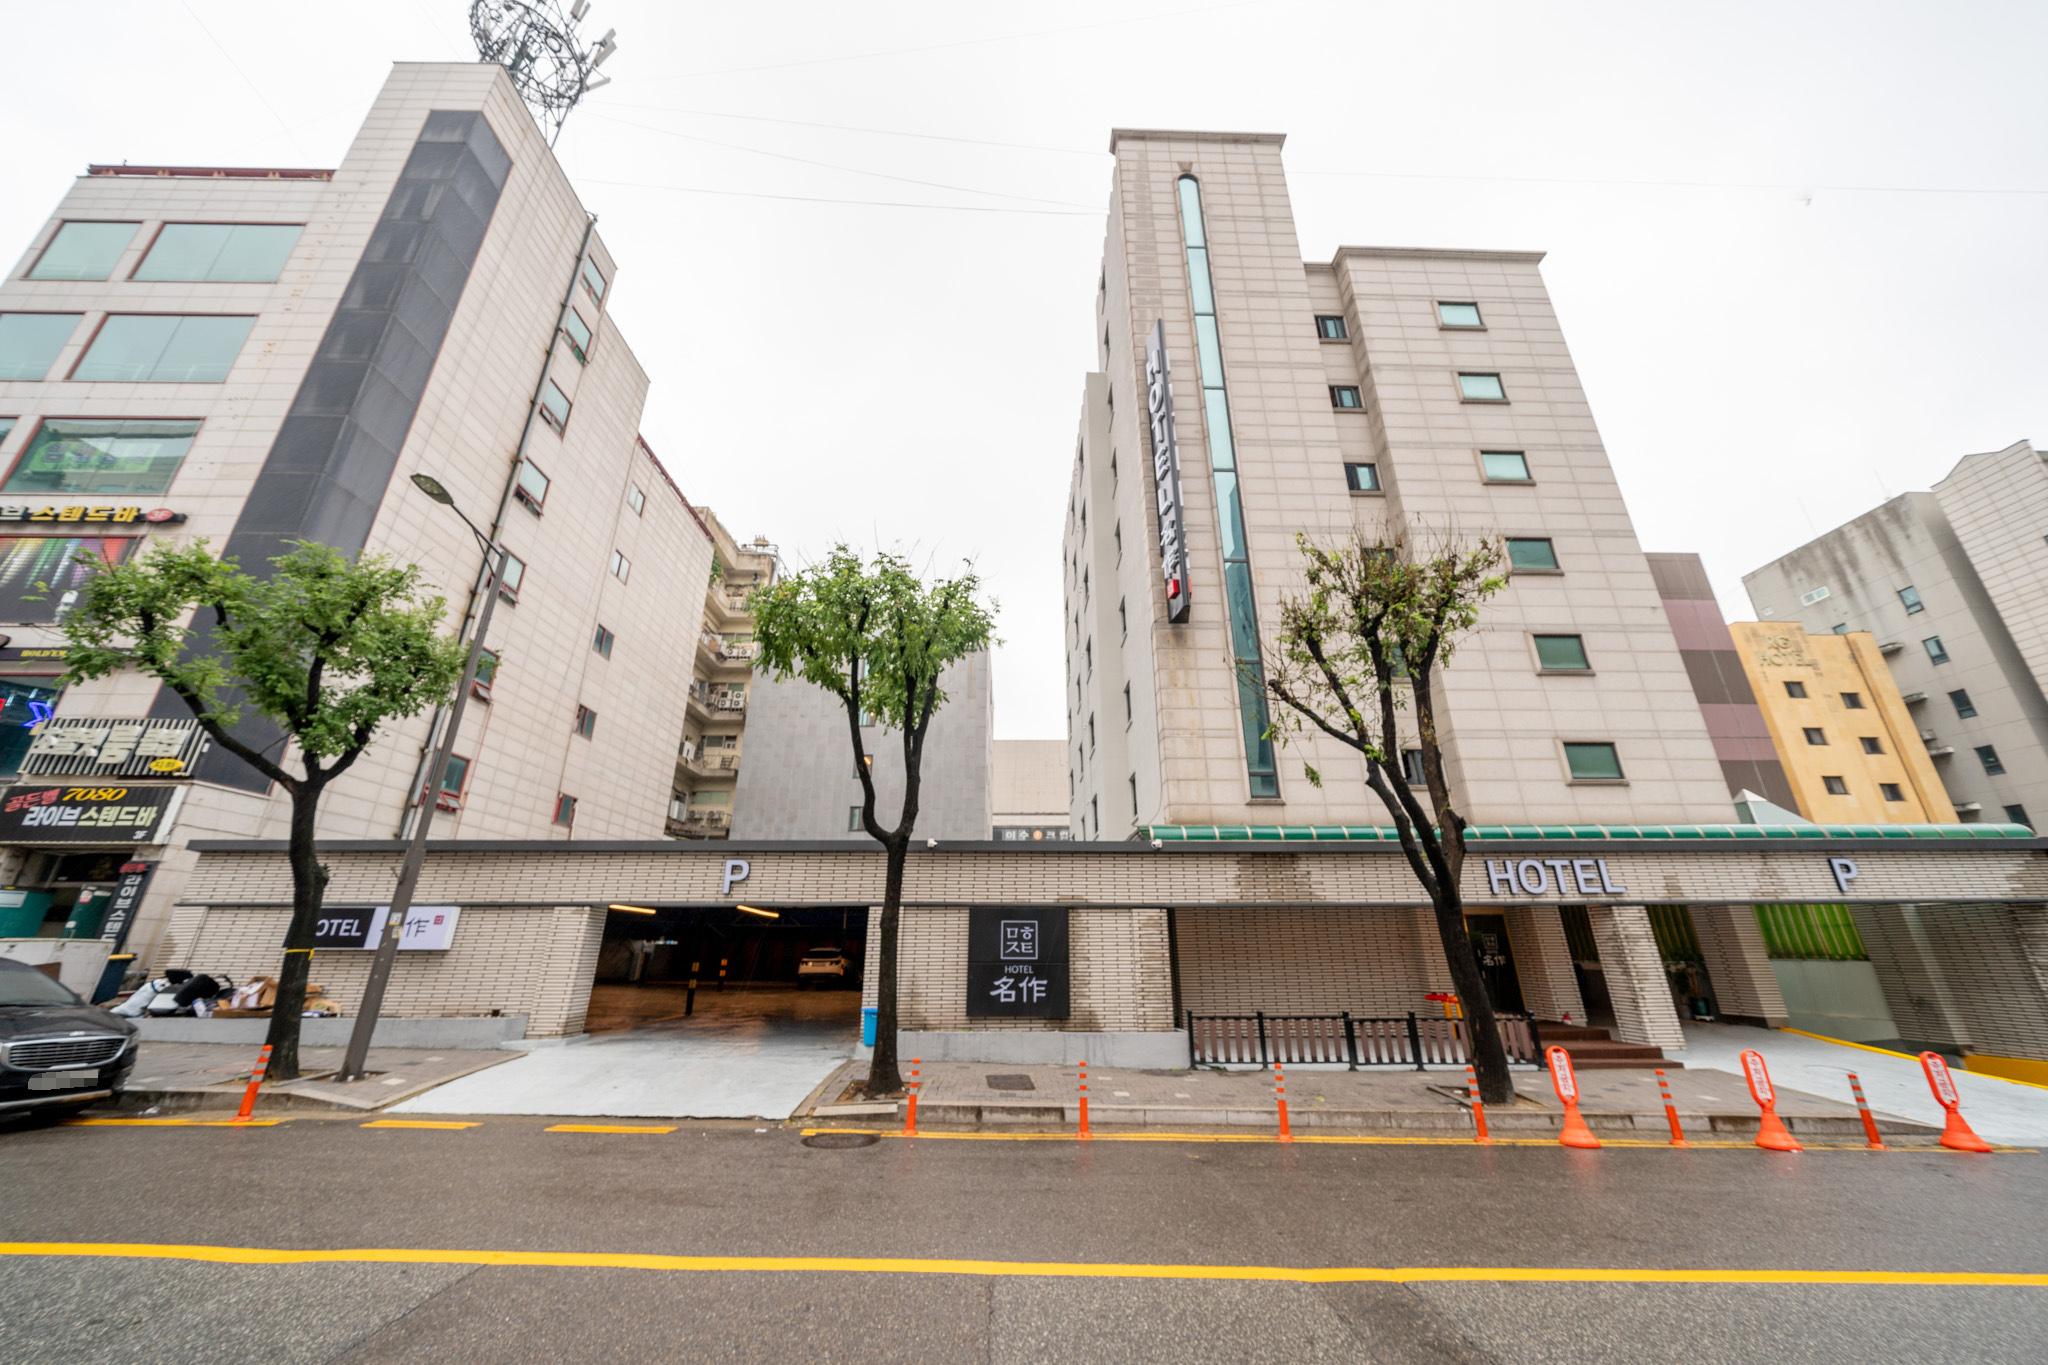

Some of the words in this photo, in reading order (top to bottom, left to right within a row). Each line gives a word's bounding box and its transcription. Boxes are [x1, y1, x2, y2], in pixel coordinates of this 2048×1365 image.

[1146, 349, 1174, 516] HOTEL
[62, 787, 128, 801] 7080
[133, 830, 148, 840] 3F
[722, 859, 751, 895] P
[1486, 858, 1628, 895] HOTEL
[1828, 857, 1858, 893] P
[315, 918, 362, 937] OTEL
[1004, 965, 1034, 974] HOTEL
[989, 975, 1048, 1004] 名作
